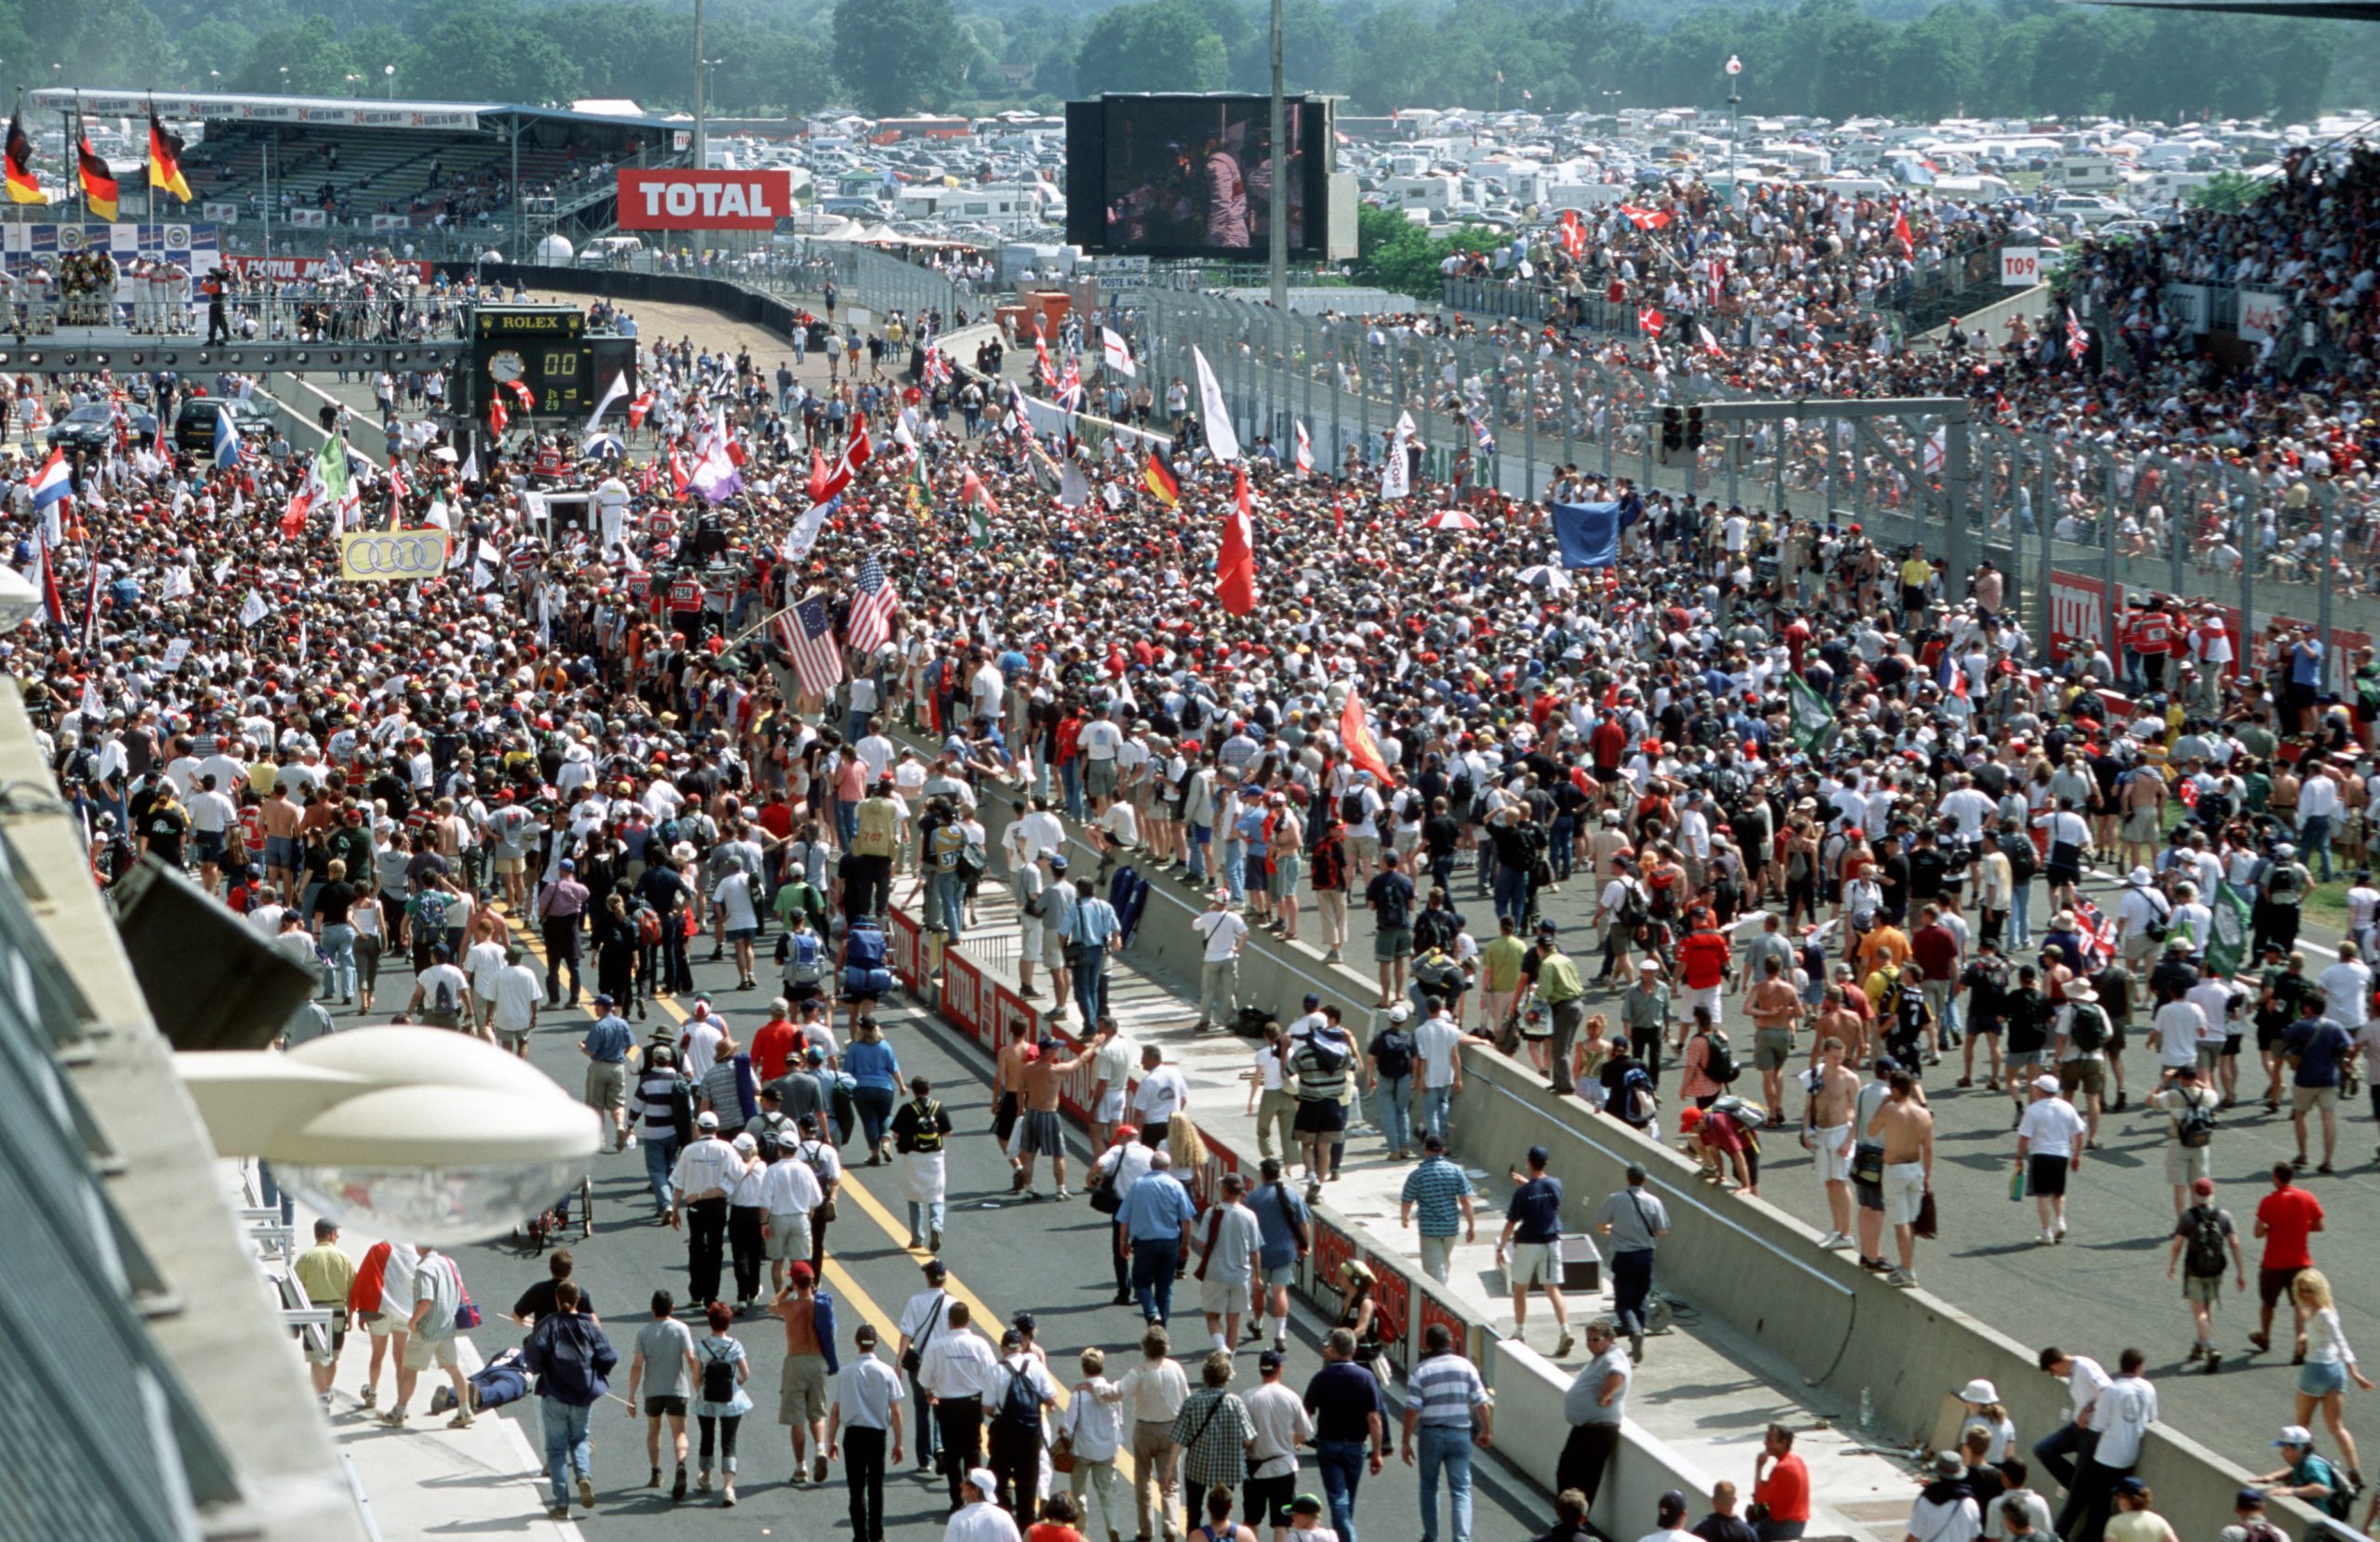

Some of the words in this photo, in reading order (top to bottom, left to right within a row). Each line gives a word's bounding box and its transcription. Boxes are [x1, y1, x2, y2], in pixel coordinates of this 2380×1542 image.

[243, 105, 253, 118] 24
[298, 107, 309, 121] 24
[353, 111, 364, 124] 24
[412, 112, 423, 125] 24
[639, 182, 772, 217] TOTAL
[245, 260, 297, 278] MOTUL
[1118, 259, 1126, 268] 4
[2005, 257, 2035, 275] T09
[1101, 278, 1124, 287] POSTE
[502, 316, 558, 328] ROLEX
[544, 353, 577, 376] 00
[545, 400, 559, 411] 29
[544, 457, 556, 467] 101
[2051, 583, 2104, 645] TOTA
[945, 957, 978, 1025] TOTAL
[1910, 1003, 1920, 1026] 7
